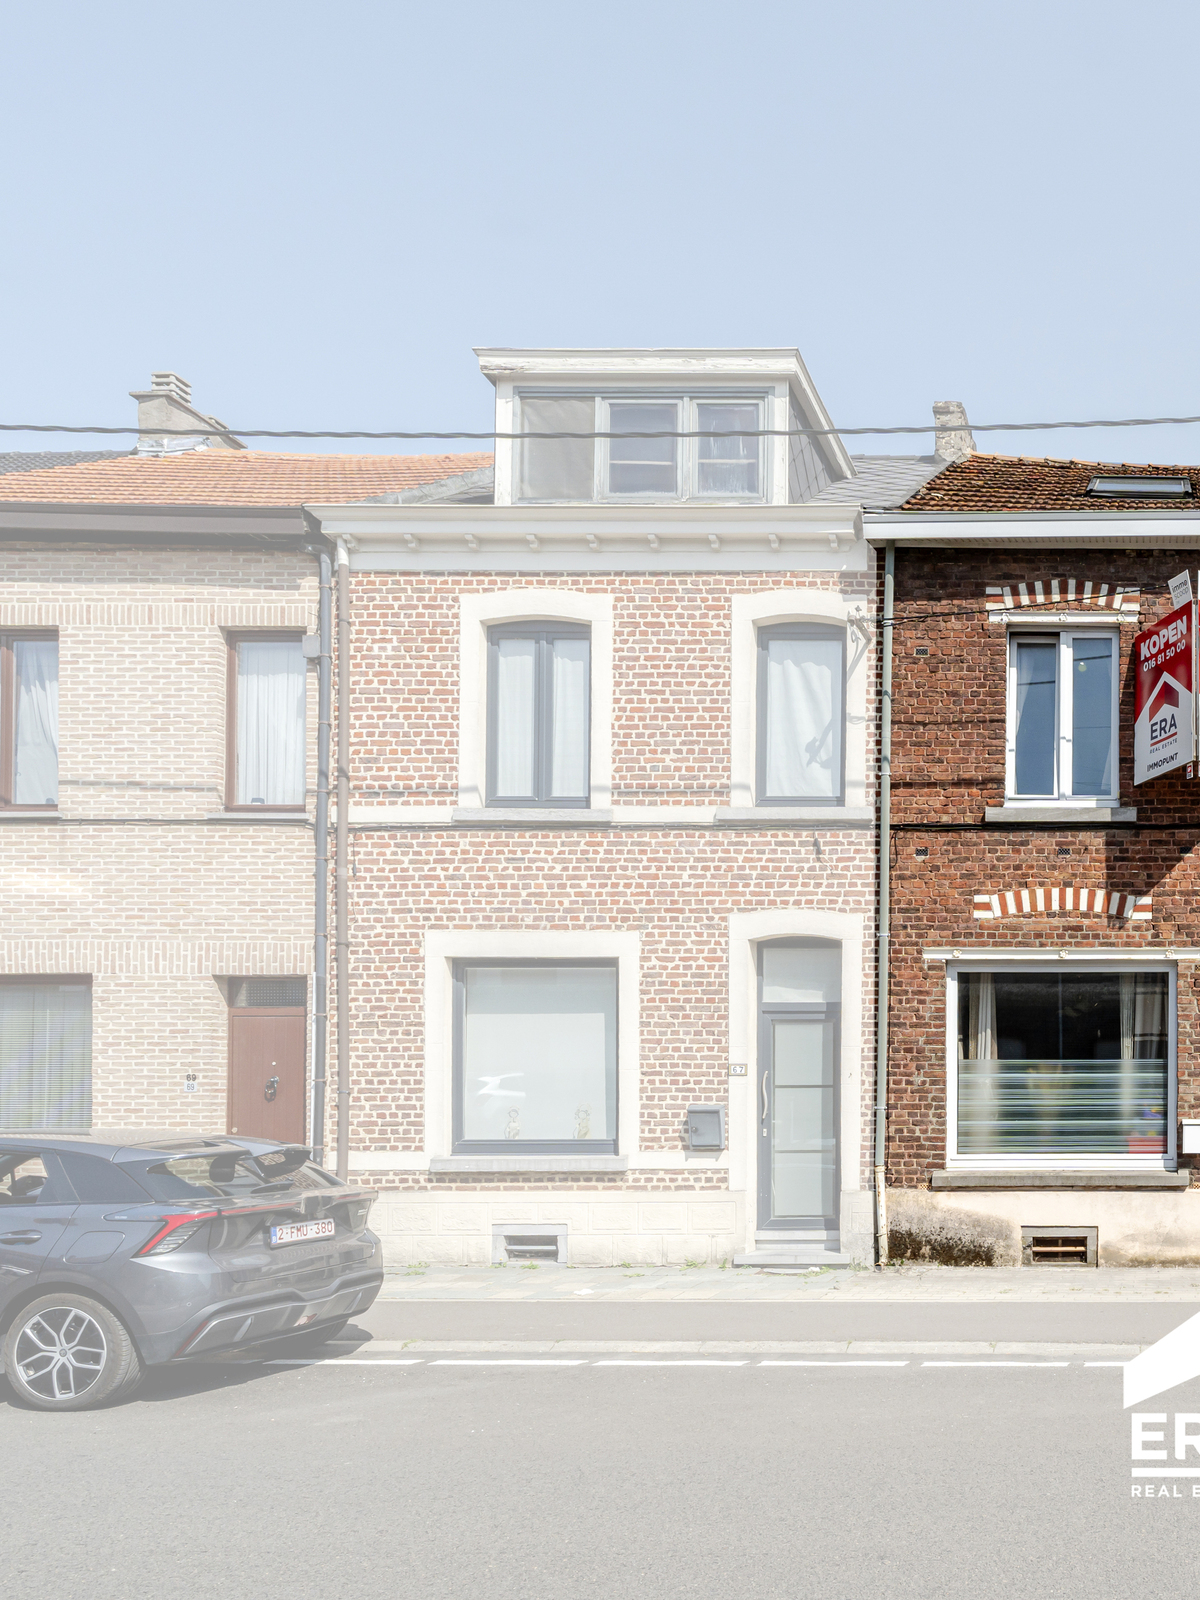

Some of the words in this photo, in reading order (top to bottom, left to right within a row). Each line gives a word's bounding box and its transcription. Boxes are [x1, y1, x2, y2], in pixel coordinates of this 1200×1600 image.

[1171, 580, 1187, 594] immo
[1174, 587, 1189, 600] scoop
[1141, 615, 1187, 661] KOPEN
[1143, 657, 1156, 672] 016
[1157, 652, 1165, 665] 81
[1166, 646, 1175, 660] 50
[1176, 639, 1186, 652] 00
[1150, 713, 1178, 741] ERA
[1149, 745, 1161, 754] REAL
[1161, 738, 1178, 750] ESTATE
[1146, 752, 1179, 772] IMMOPUNT
[186, 1073, 197, 1082] 69
[732, 1066, 744, 1074] 67
[187, 1083, 195, 1091] 69
[277, 1220, 333, 1241] 2-FMU-380
